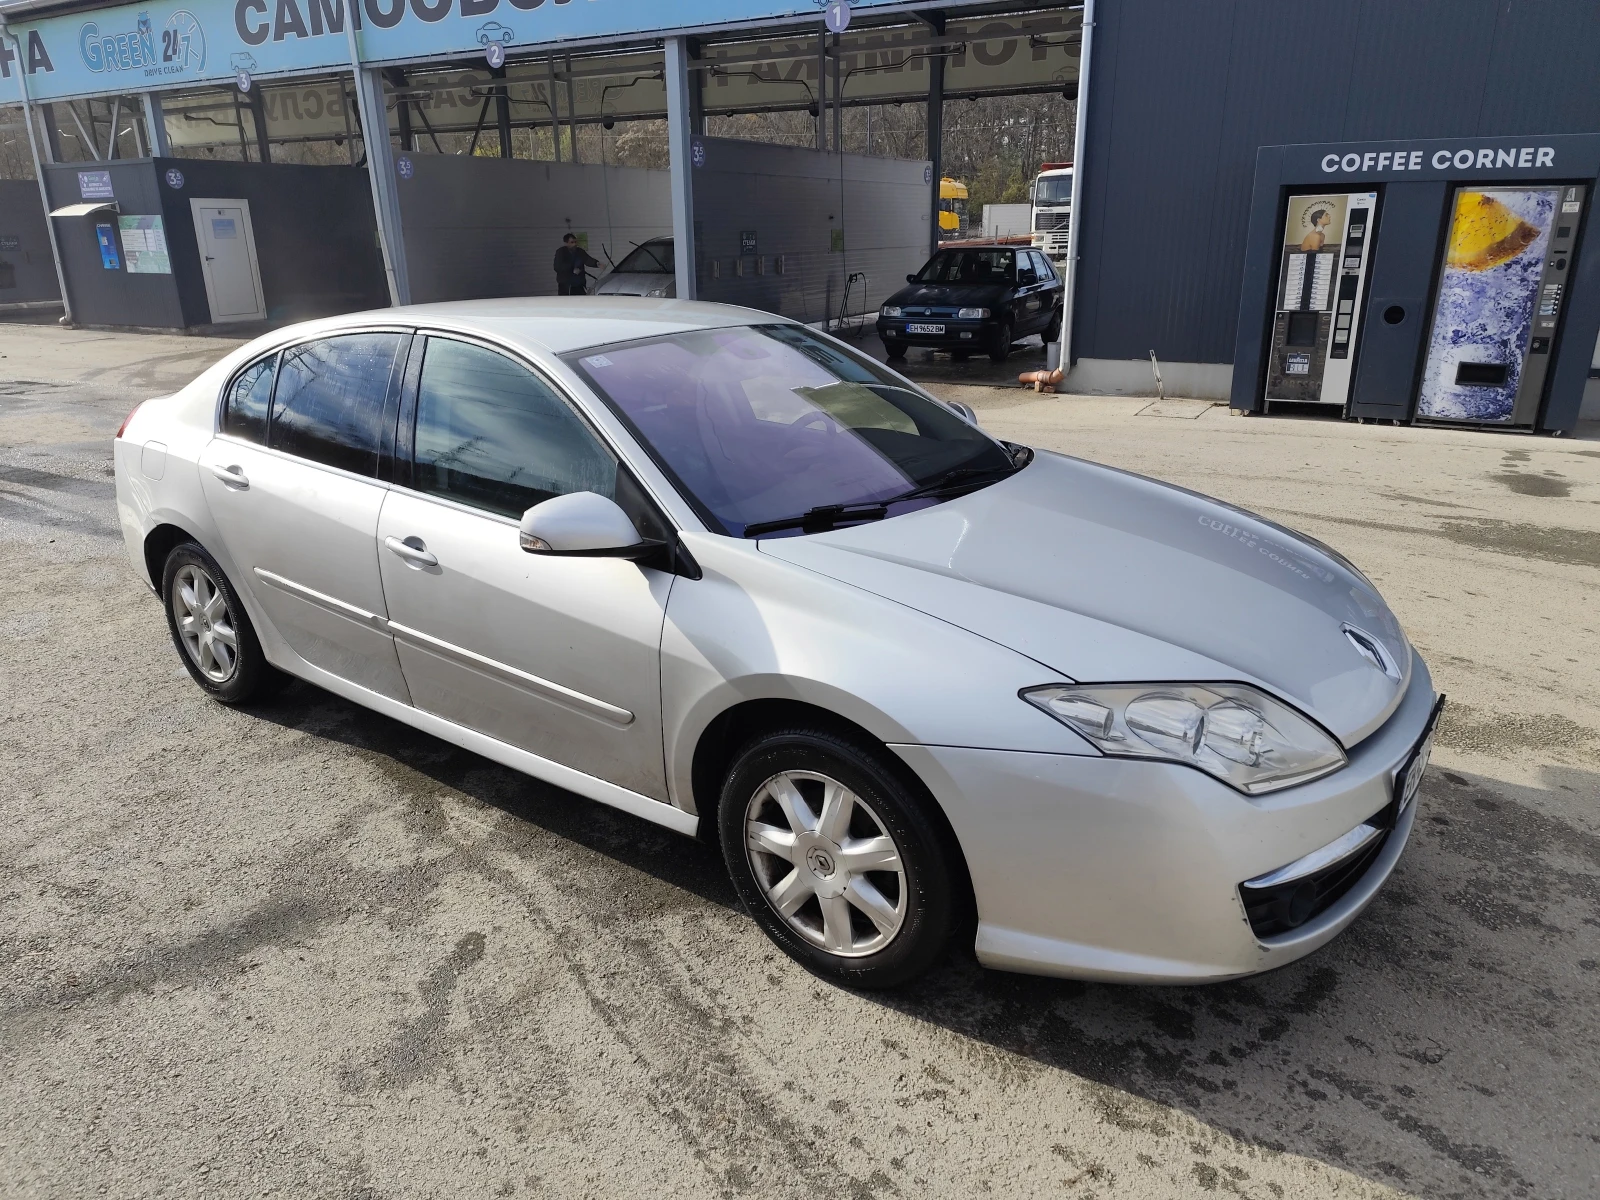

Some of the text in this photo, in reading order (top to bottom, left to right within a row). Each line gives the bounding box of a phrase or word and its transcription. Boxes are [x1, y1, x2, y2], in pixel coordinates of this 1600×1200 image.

[833, 6, 841, 27] 1
[79, 22, 158, 73] GREEN
[491, 45, 501, 64] 2
[144, 64, 184, 77] DRIVE CLEAN
[240, 73, 248, 89] 3
[1321, 147, 1556, 173] COFFEE CORNER
